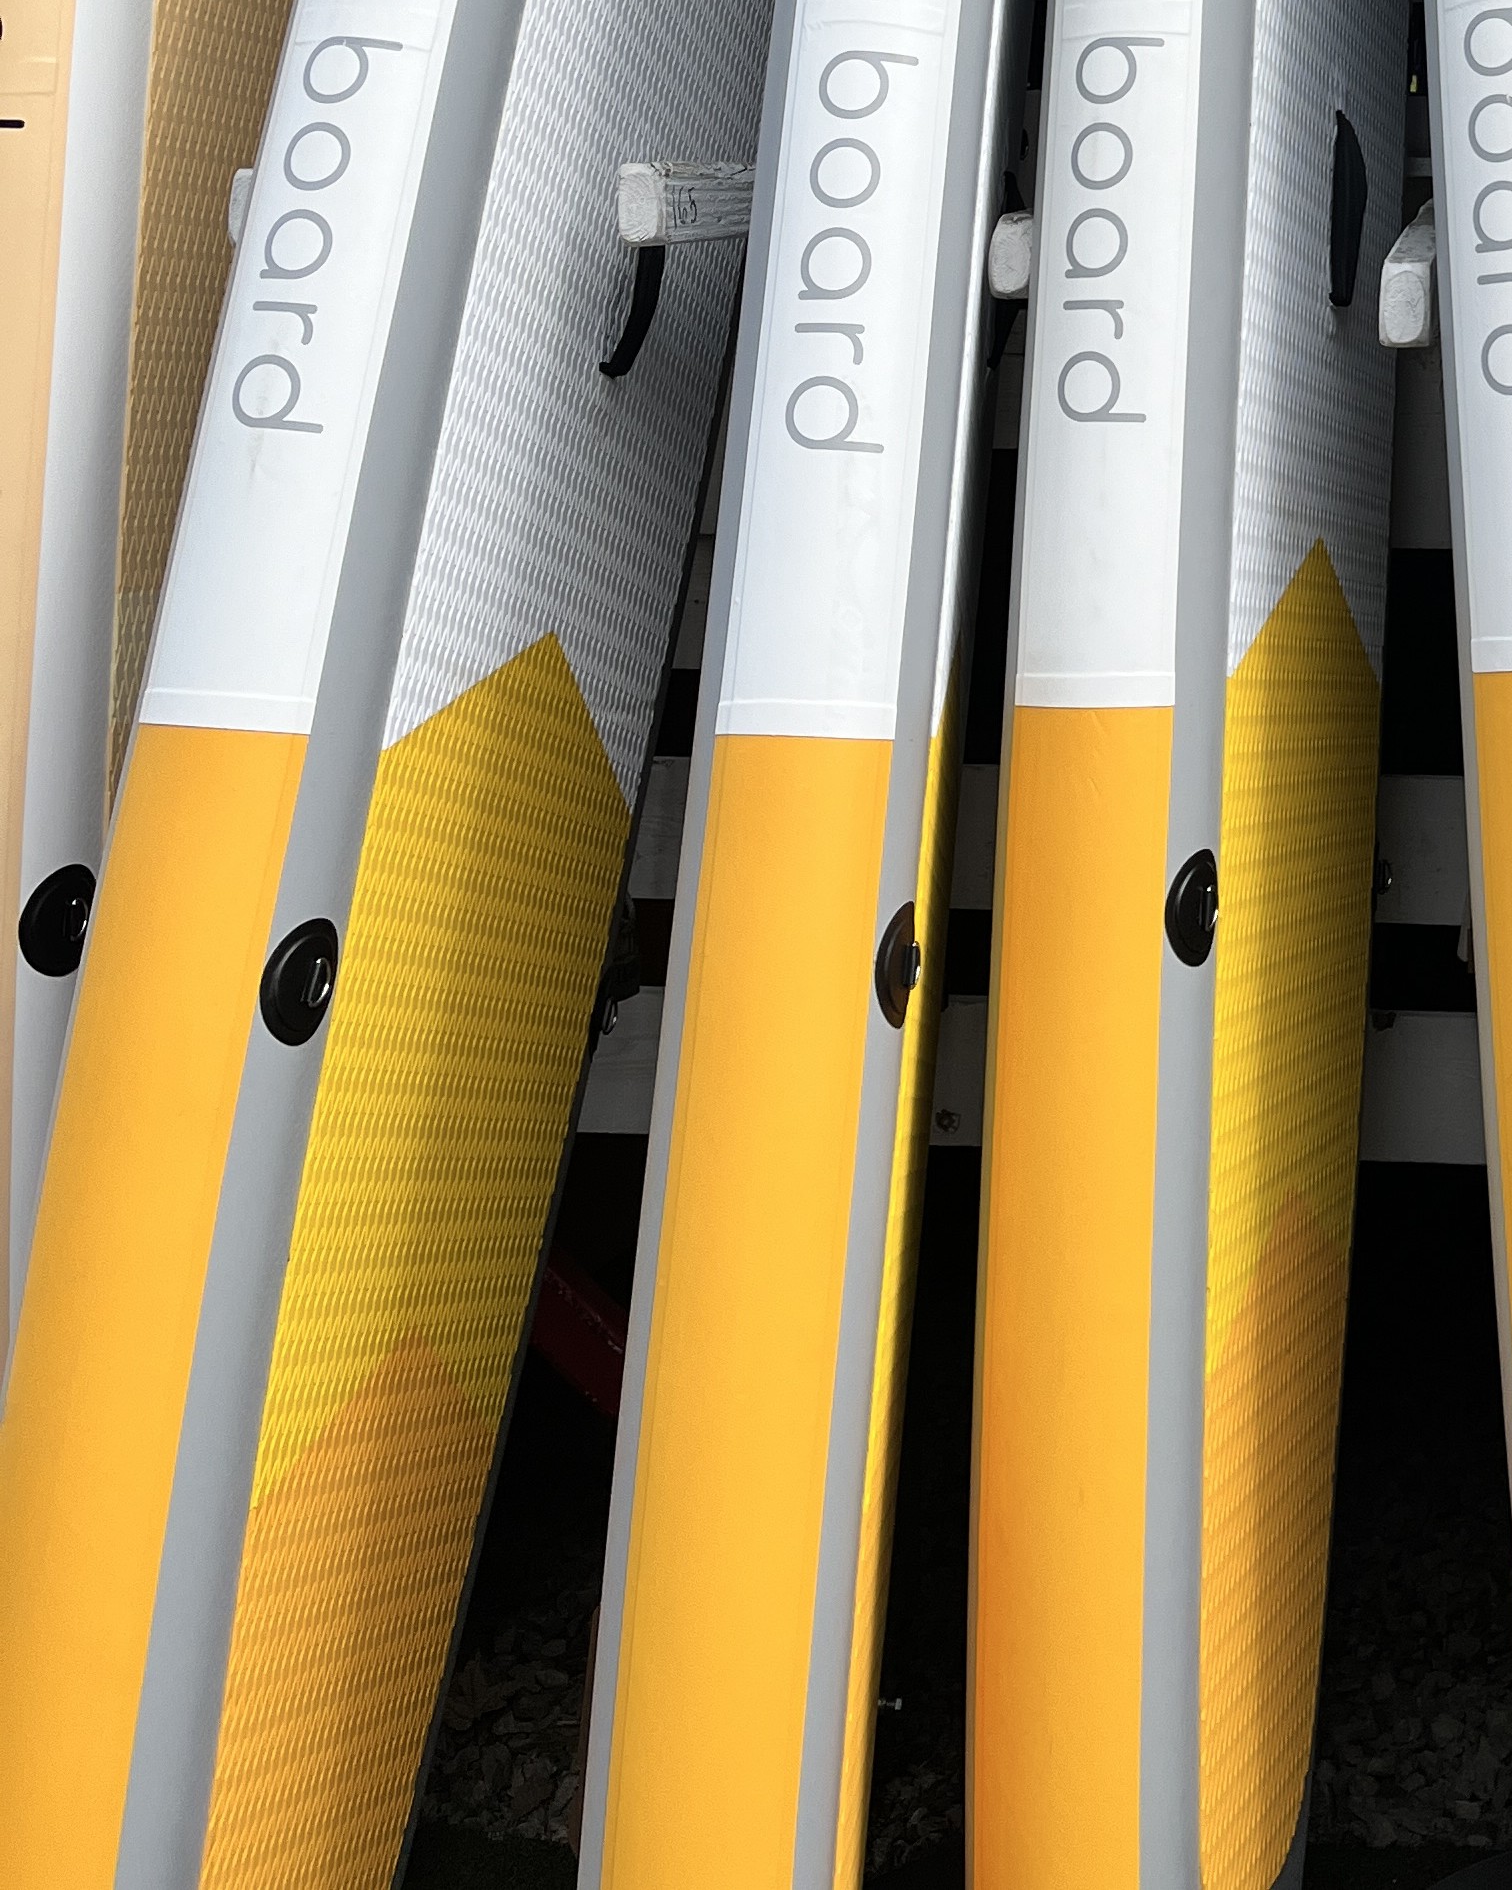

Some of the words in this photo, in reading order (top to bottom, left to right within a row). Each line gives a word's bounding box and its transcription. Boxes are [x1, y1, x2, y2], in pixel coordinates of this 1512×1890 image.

[231, 35, 404, 434] board
[671, 185, 698, 230] 165
[784, 49, 920, 454] board
[1057, 36, 1165, 424] board
